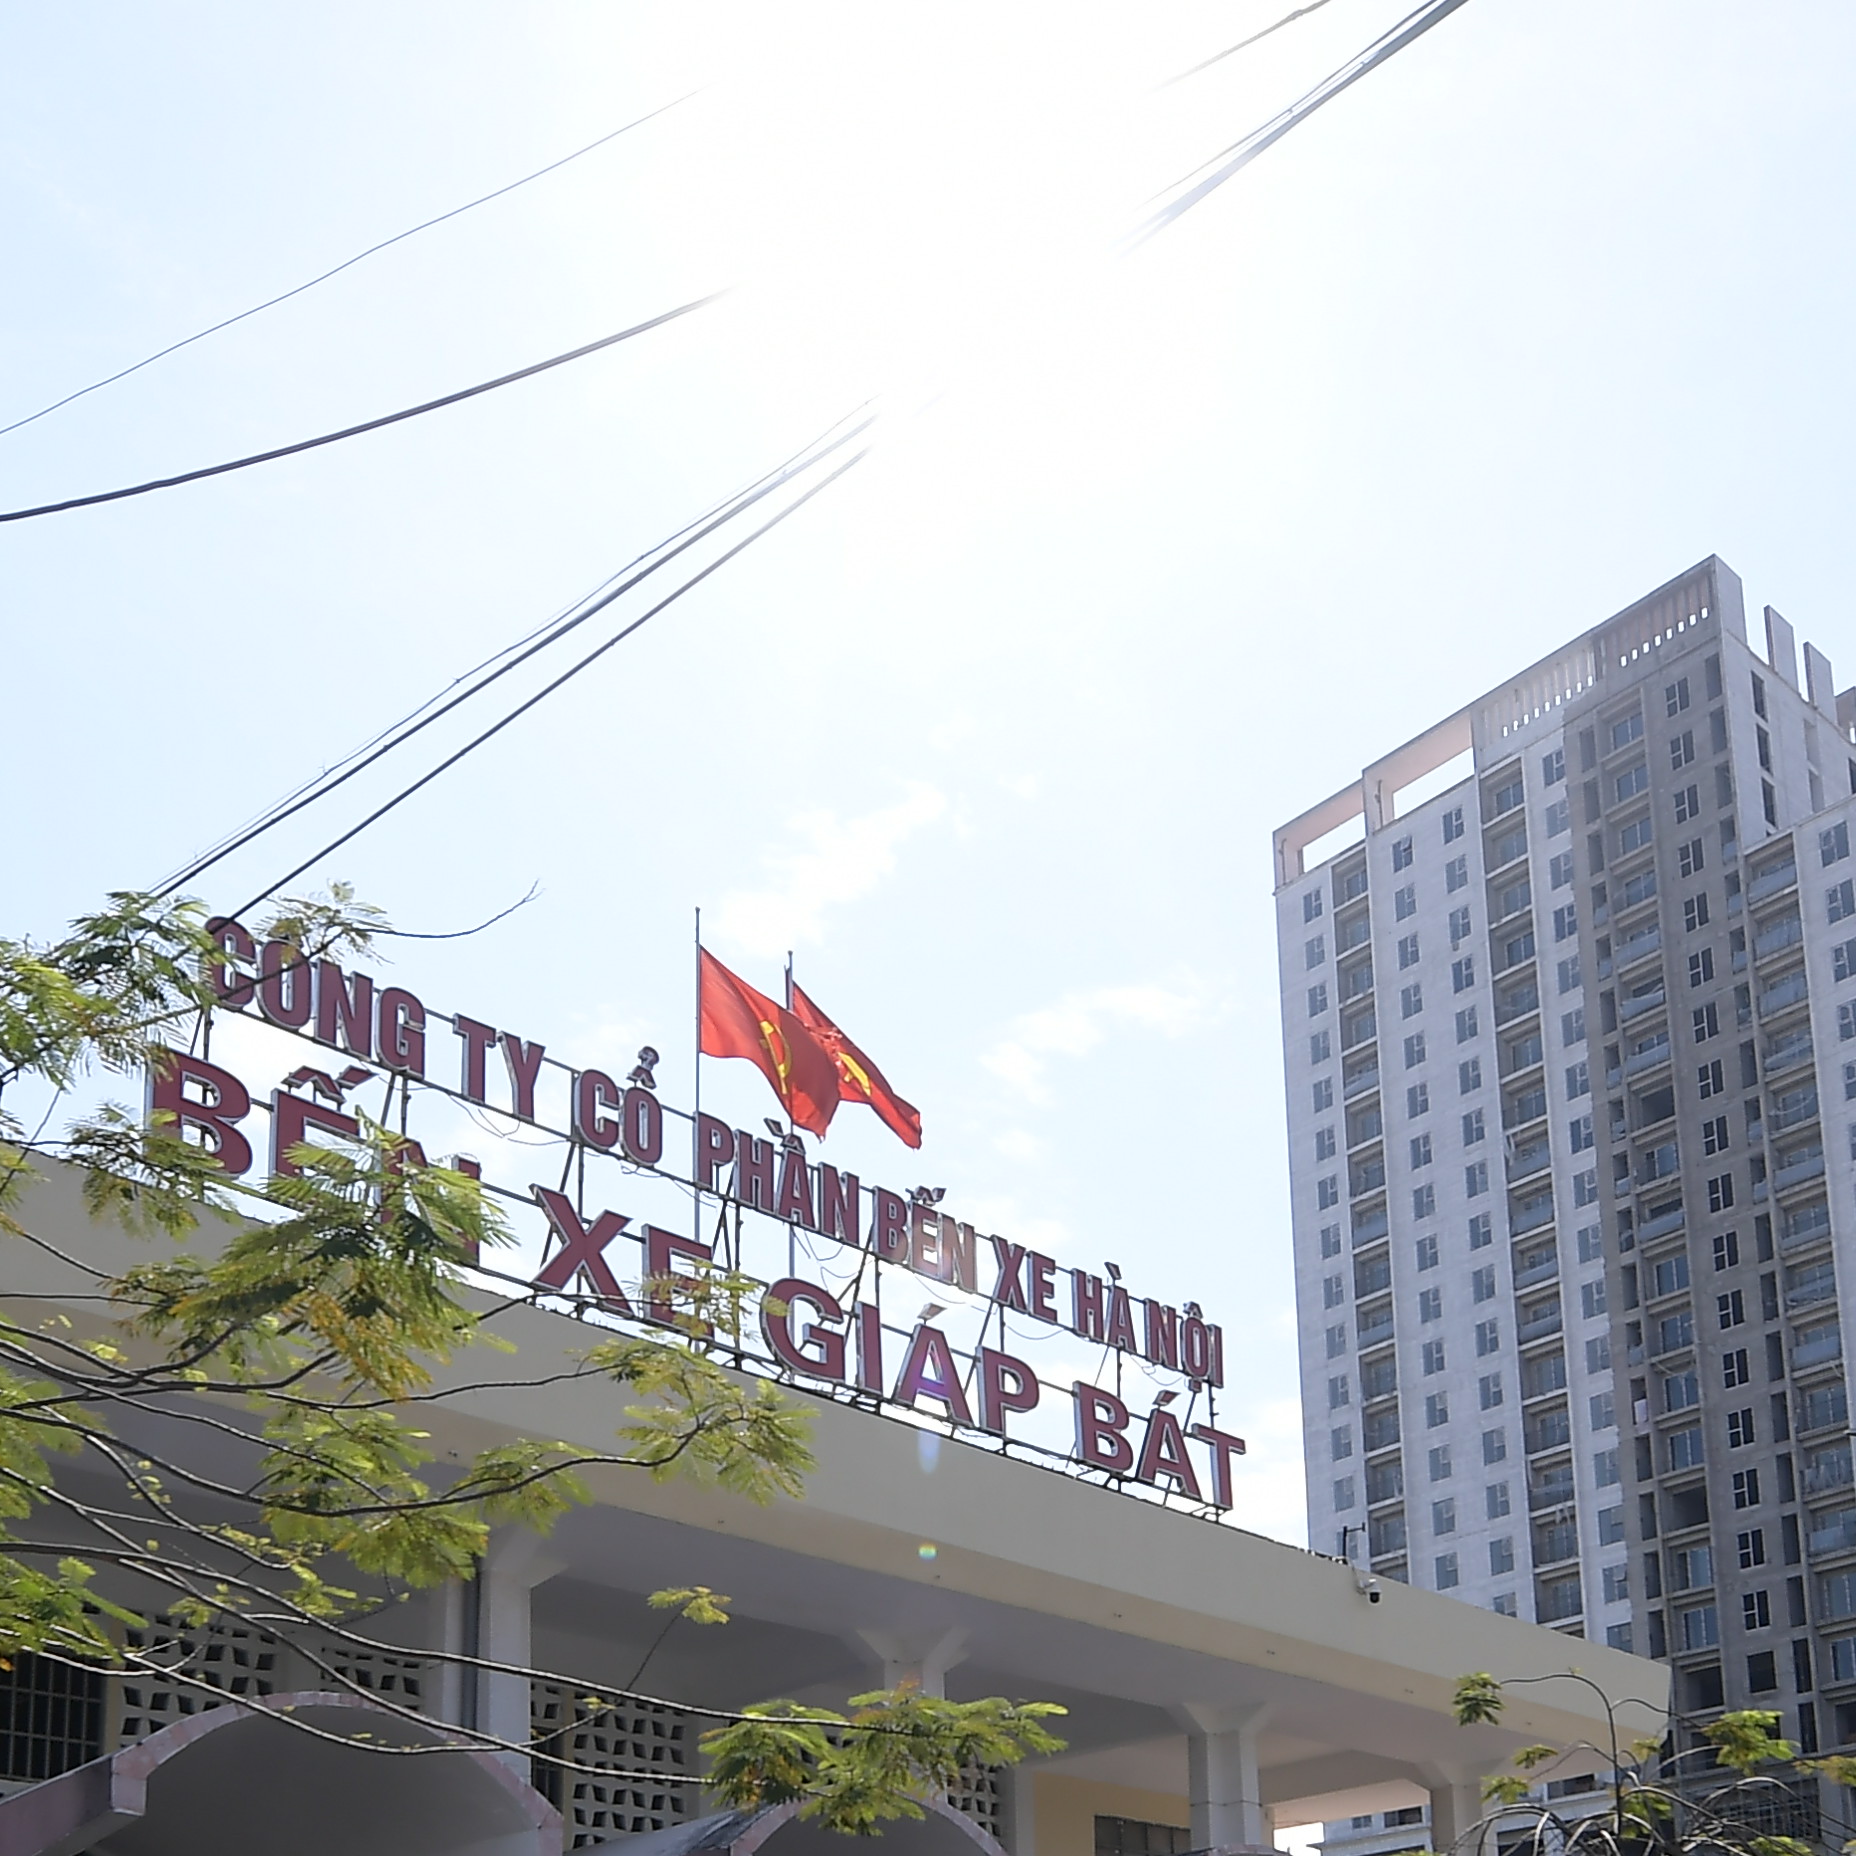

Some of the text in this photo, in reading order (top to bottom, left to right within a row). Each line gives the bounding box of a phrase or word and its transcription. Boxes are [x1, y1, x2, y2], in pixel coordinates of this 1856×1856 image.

[452, 1012, 547, 1126] TY
[574, 1045, 663, 1167] CỔ
[692, 1110, 860, 1247] PHẦN
[871, 1185, 978, 1294] BẾN
[989, 1233, 1059, 1325] XE
[1070, 1261, 1138, 1355] HÀ
[1142, 1296, 1224, 1393] NỘI
[528, 1183, 715, 1339] XE
[759, 1277, 1040, 1436] GIÁP
[1072, 1380, 1246, 1511] BÁT
